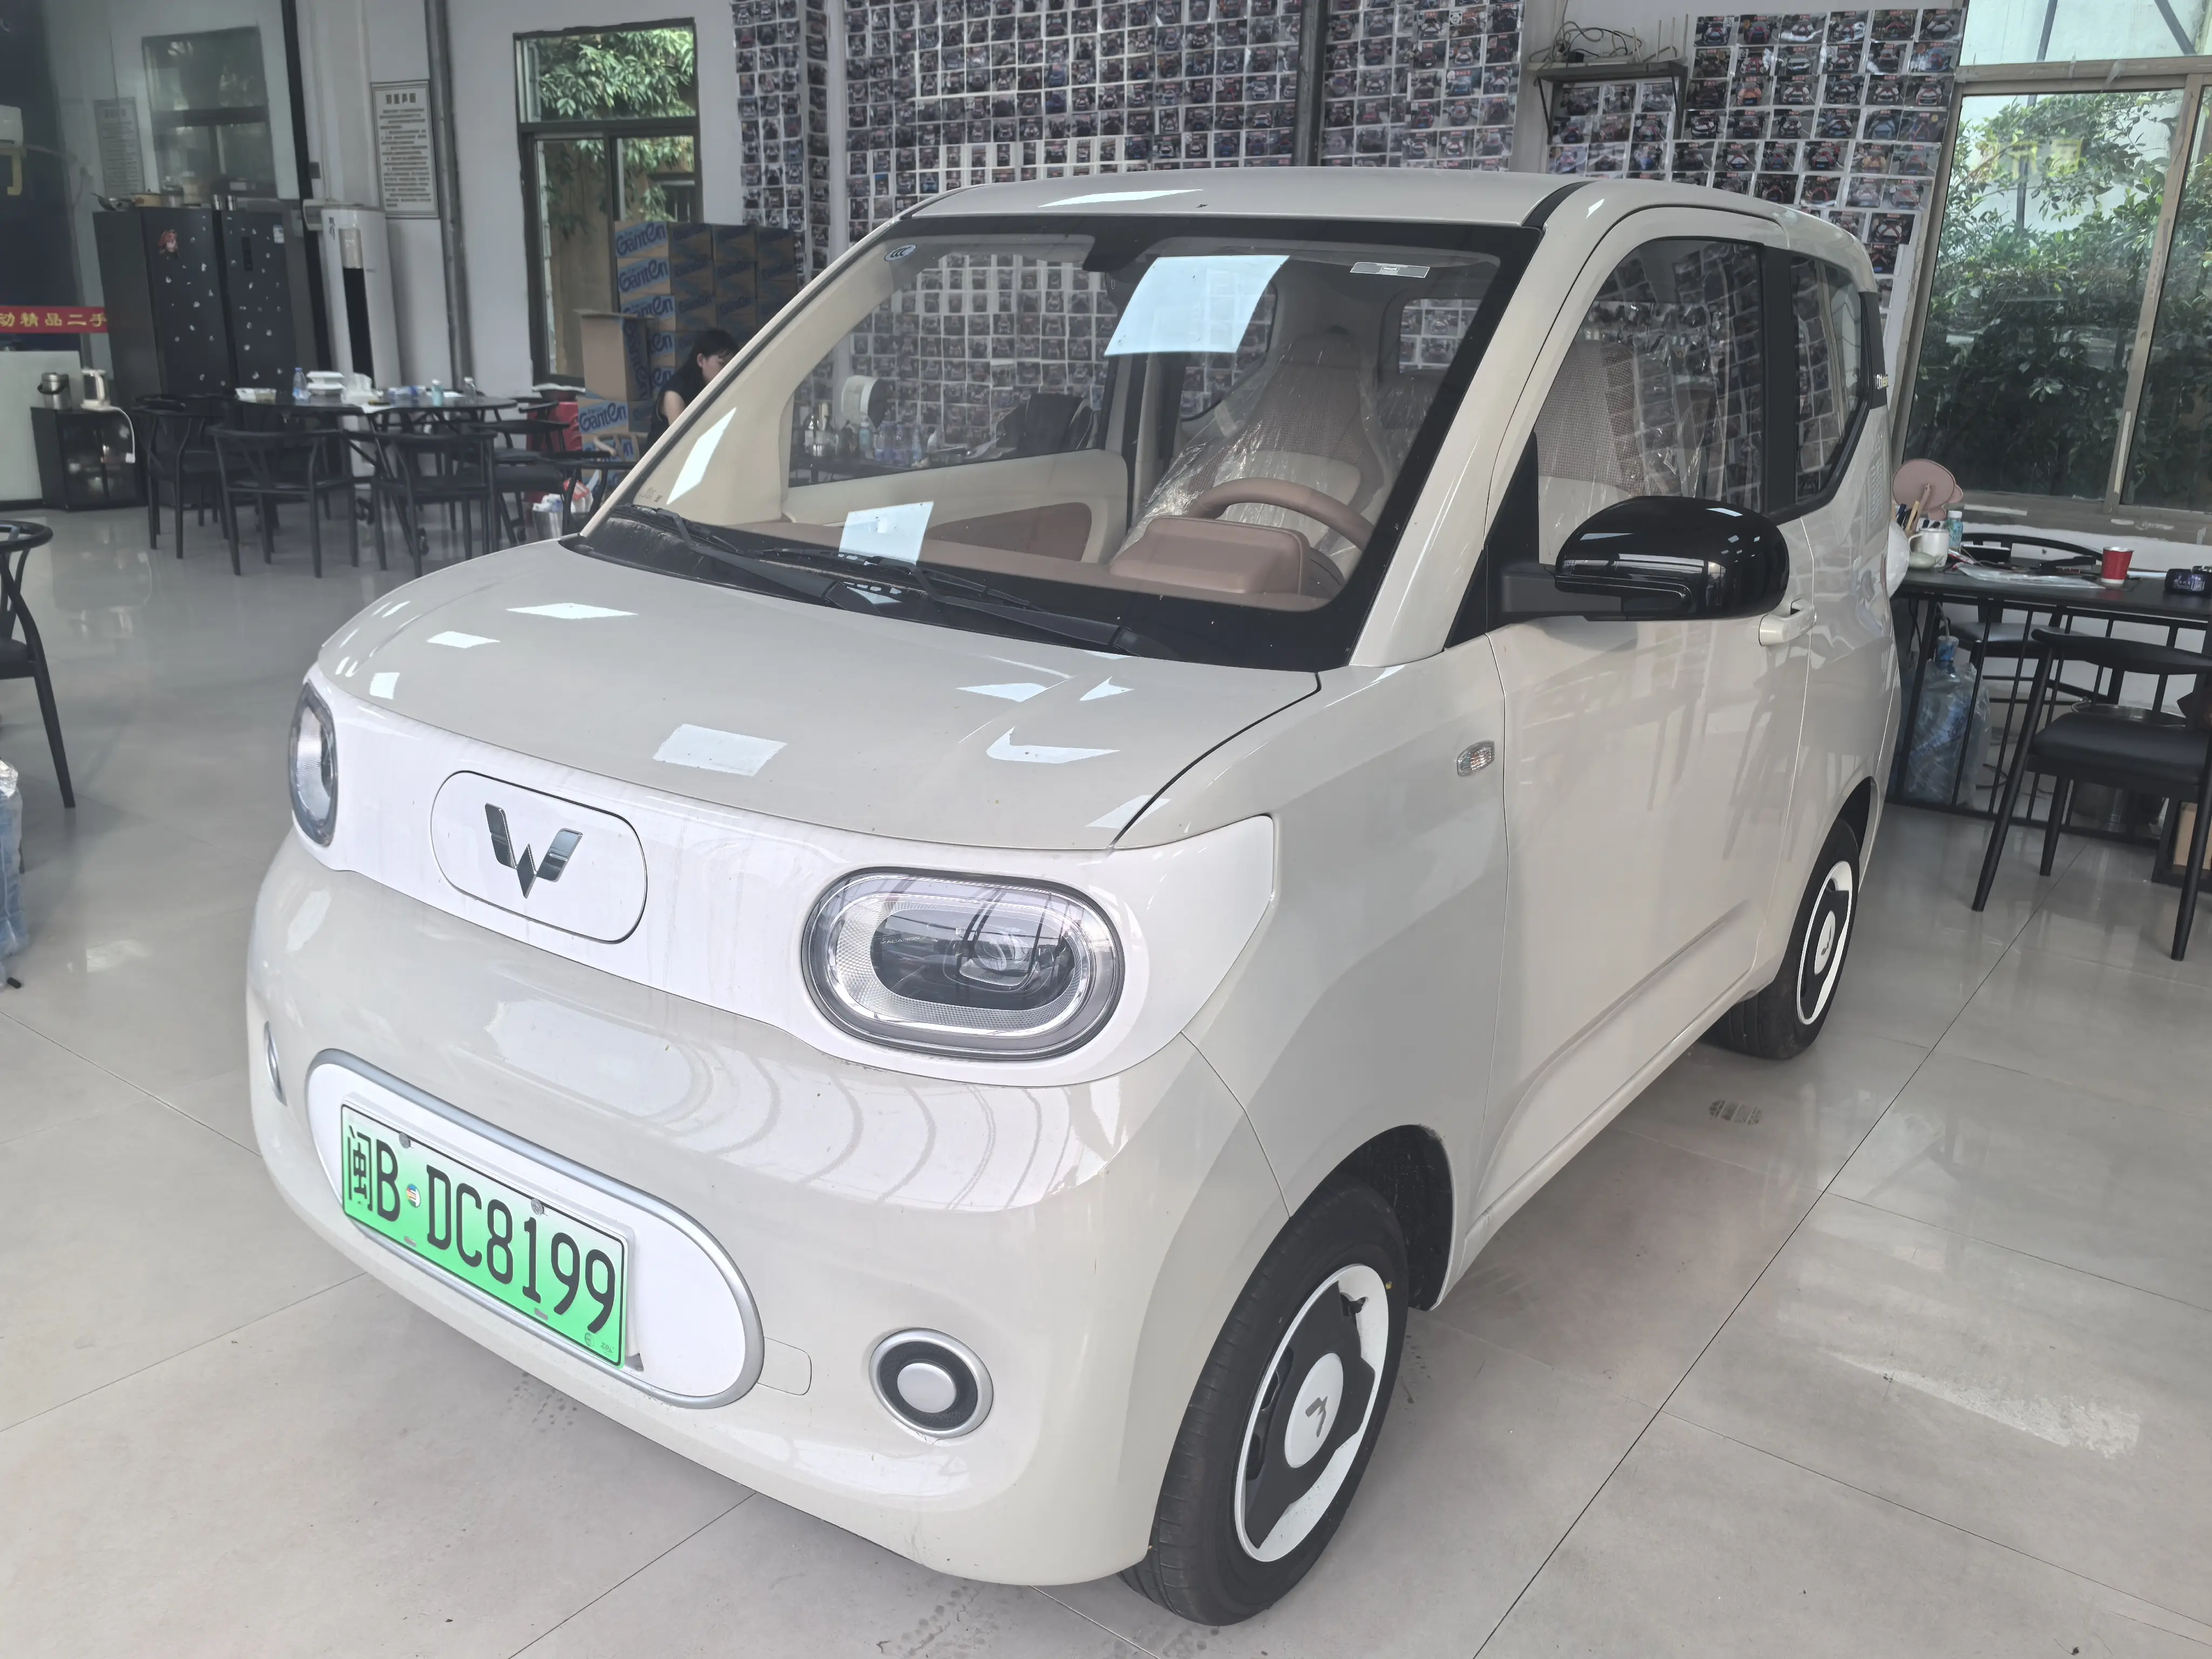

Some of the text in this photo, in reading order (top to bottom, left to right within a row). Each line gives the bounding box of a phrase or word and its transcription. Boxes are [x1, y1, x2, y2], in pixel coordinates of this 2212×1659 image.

[619, 259, 669, 292] Ganten
[623, 296, 674, 318] nten
[579, 402, 627, 432] Ganten
